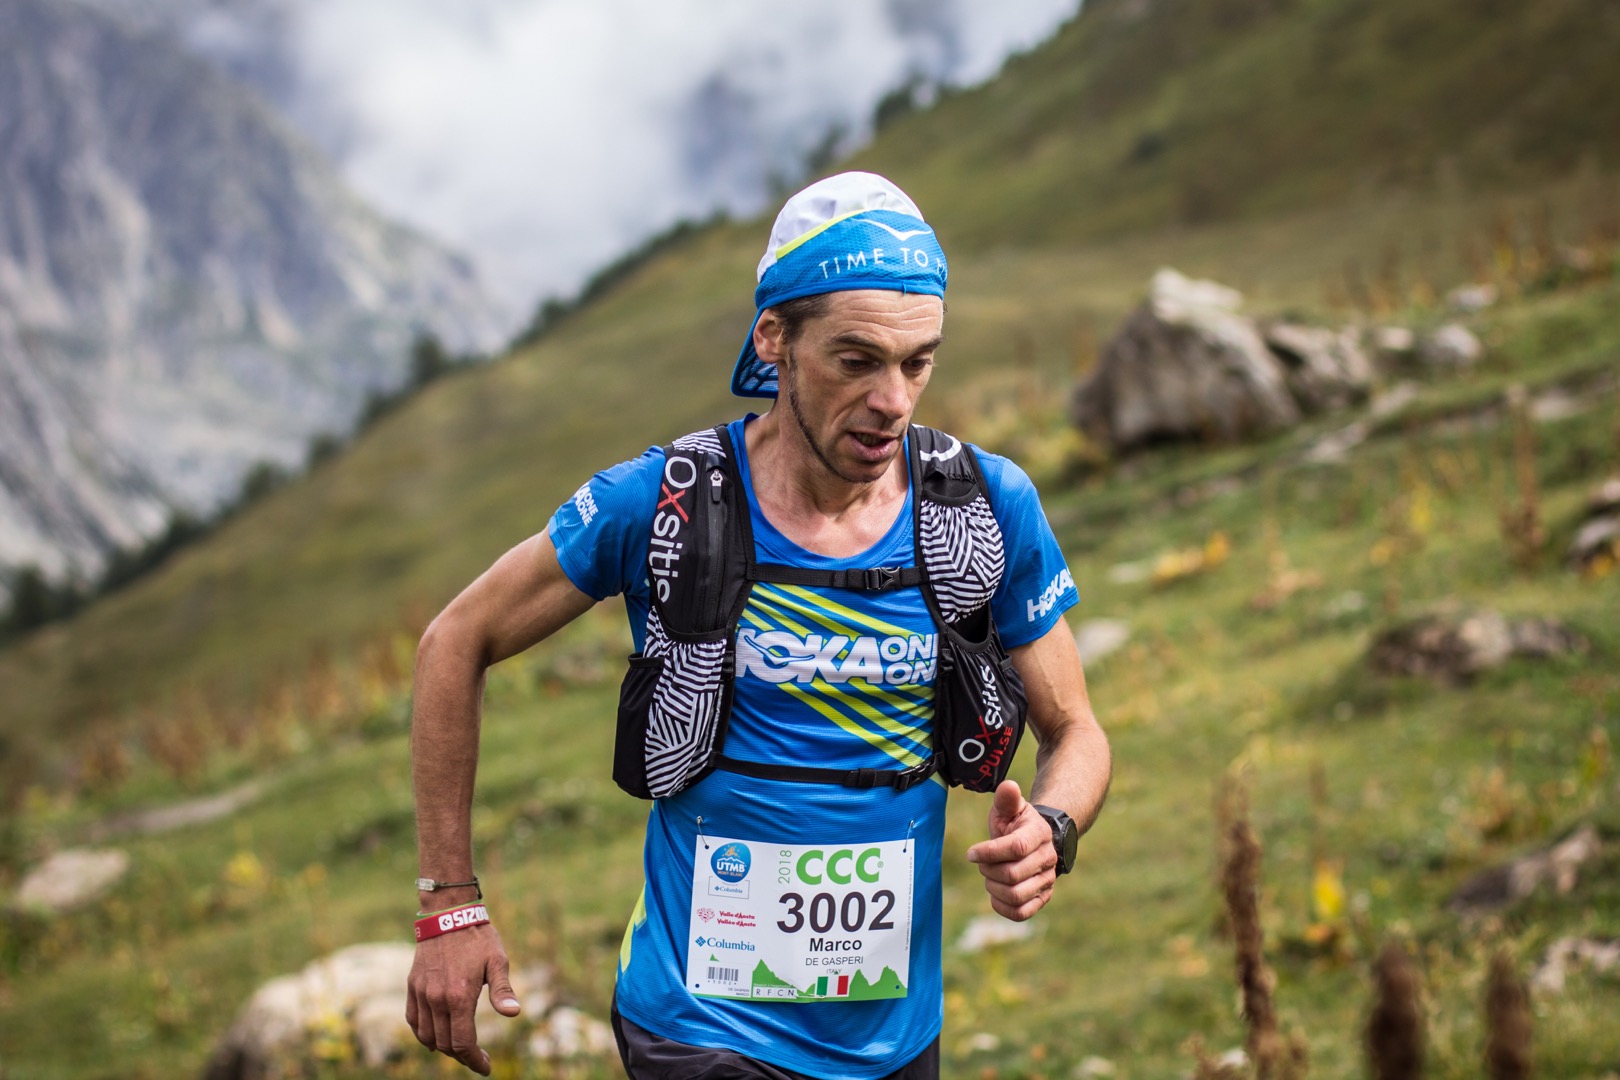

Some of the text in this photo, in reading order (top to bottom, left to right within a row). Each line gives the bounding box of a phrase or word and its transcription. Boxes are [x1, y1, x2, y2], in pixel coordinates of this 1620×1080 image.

[818, 247, 929, 279] TIME TO
[577, 501, 593, 528] ONE
[584, 492, 599, 517] ONE
[1026, 567, 1074, 622] HOKA
[880, 633, 938, 662] ON
[885, 658, 938, 685] ON
[979, 726, 1013, 777] PULSE
[716, 860, 746, 873] UTMB
[778, 849, 792, 884] 2018
[719, 886, 743, 894] Columbia
[776, 889, 896, 934] 3002
[706, 937, 756, 952] Columbia
[809, 937, 862, 952] Marco
[805, 956, 864, 966] DE GASPERI
